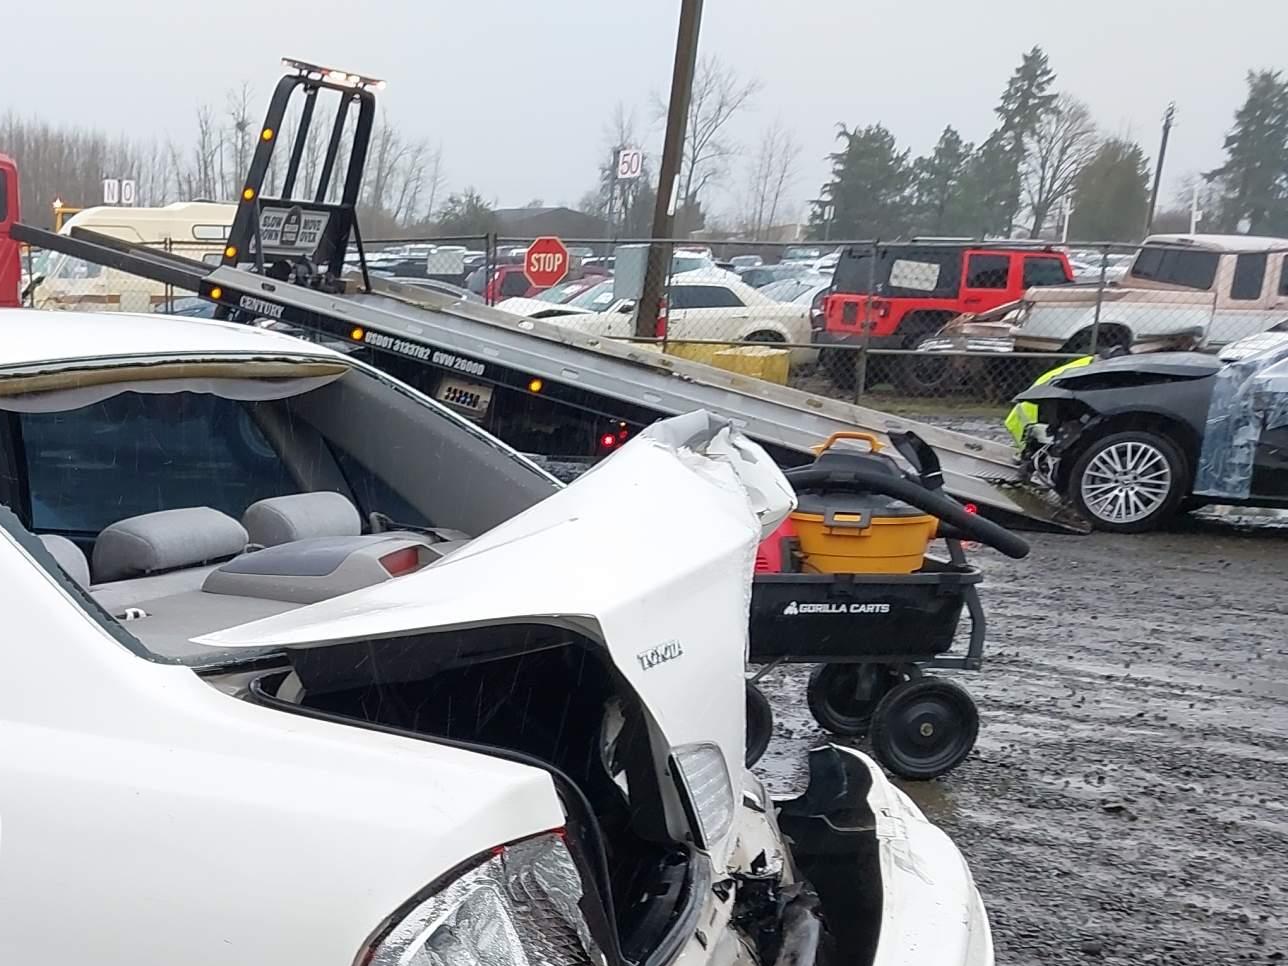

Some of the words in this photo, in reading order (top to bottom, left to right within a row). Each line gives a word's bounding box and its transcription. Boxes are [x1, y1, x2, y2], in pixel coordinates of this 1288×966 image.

[620, 152, 640, 175] 50
[262, 215, 283, 228] SLOW
[303, 218, 322, 231] MOVE
[299, 231, 317, 243] OVER
[530, 253, 562, 272] STOP
[240, 295, 285, 318] CENTURY
[365, 331, 394, 349] USDOT
[432, 351, 456, 367] GVW
[453, 357, 485, 376] 26000
[799, 603, 847, 614] GORILLA
[850, 603, 890, 614] CARTS
